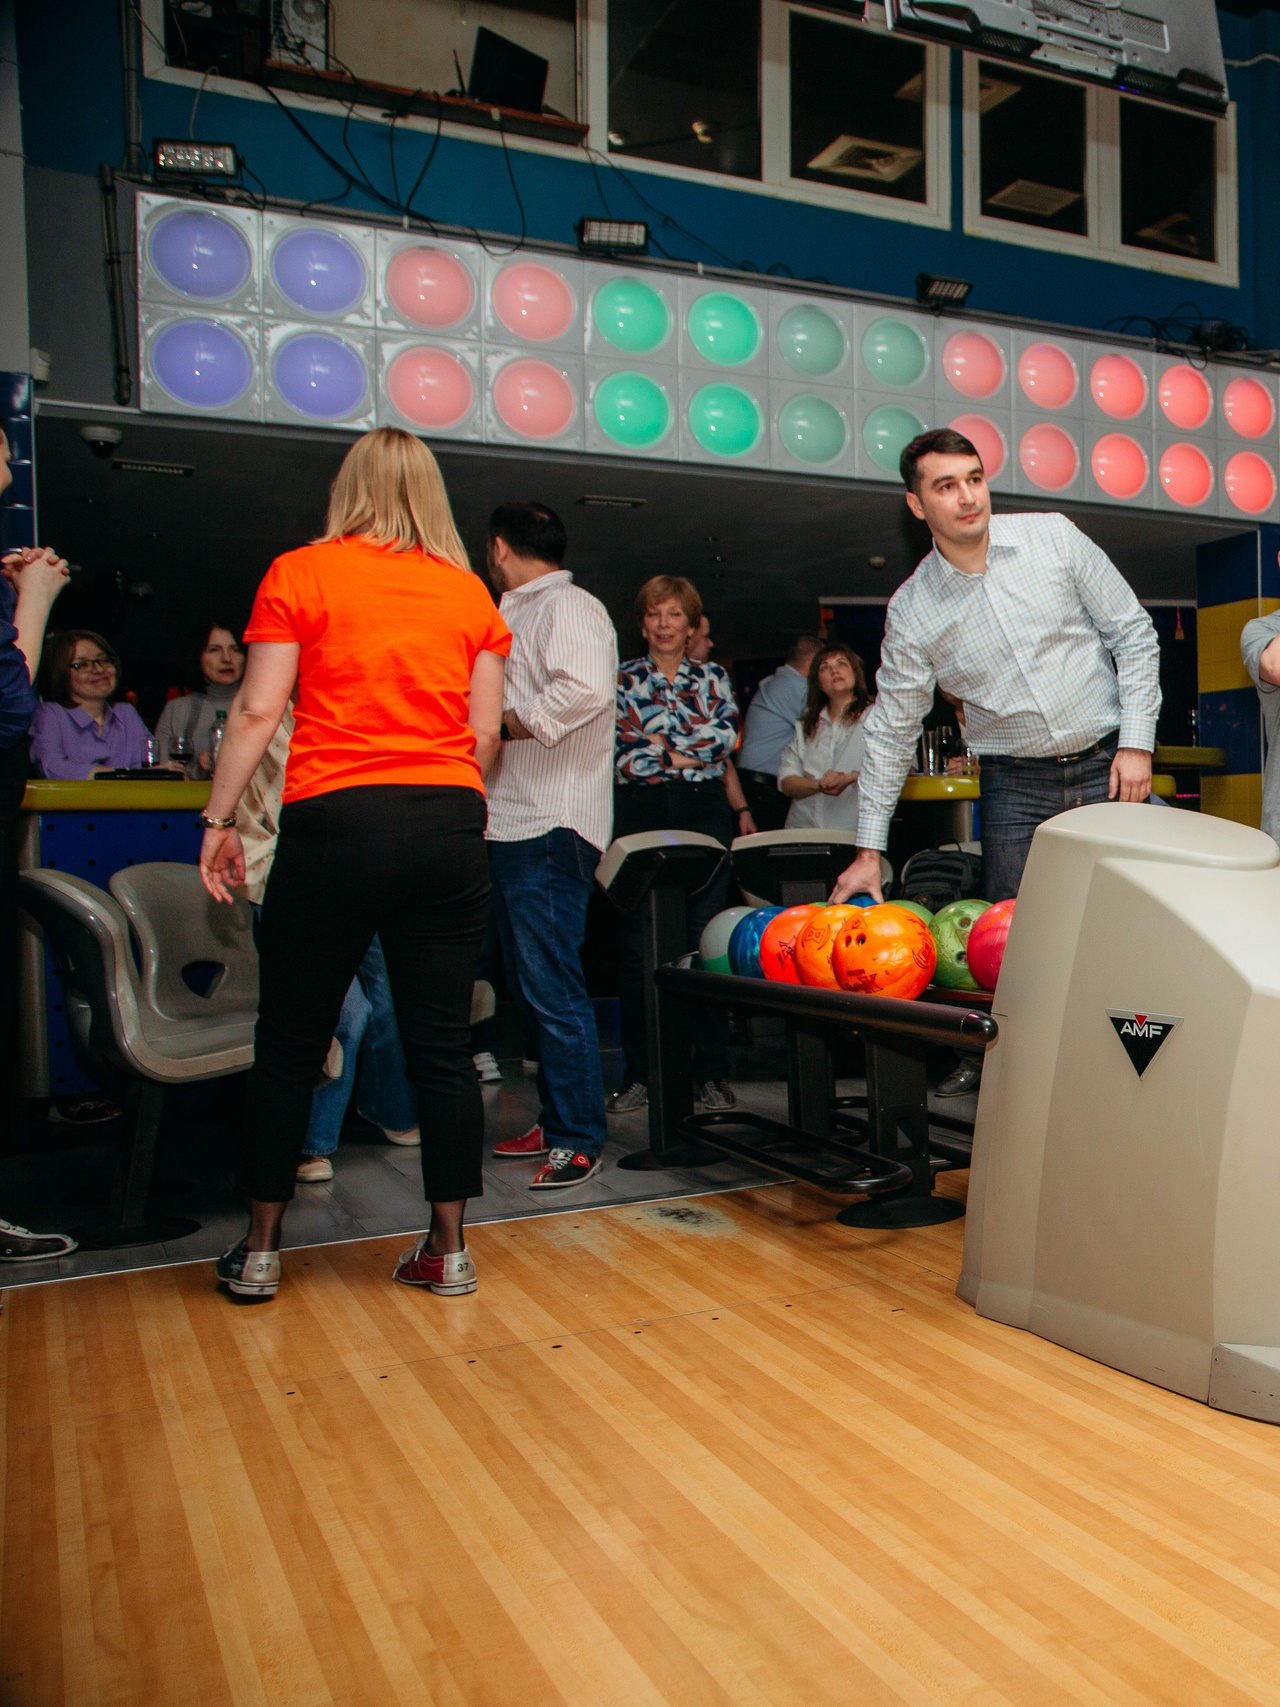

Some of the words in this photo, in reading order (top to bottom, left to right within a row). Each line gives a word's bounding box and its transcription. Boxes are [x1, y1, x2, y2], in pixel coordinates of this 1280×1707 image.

[1120, 1021, 1163, 1038] AMF
[256, 1263, 271, 1272] 37
[457, 1262, 469, 1272] 37
